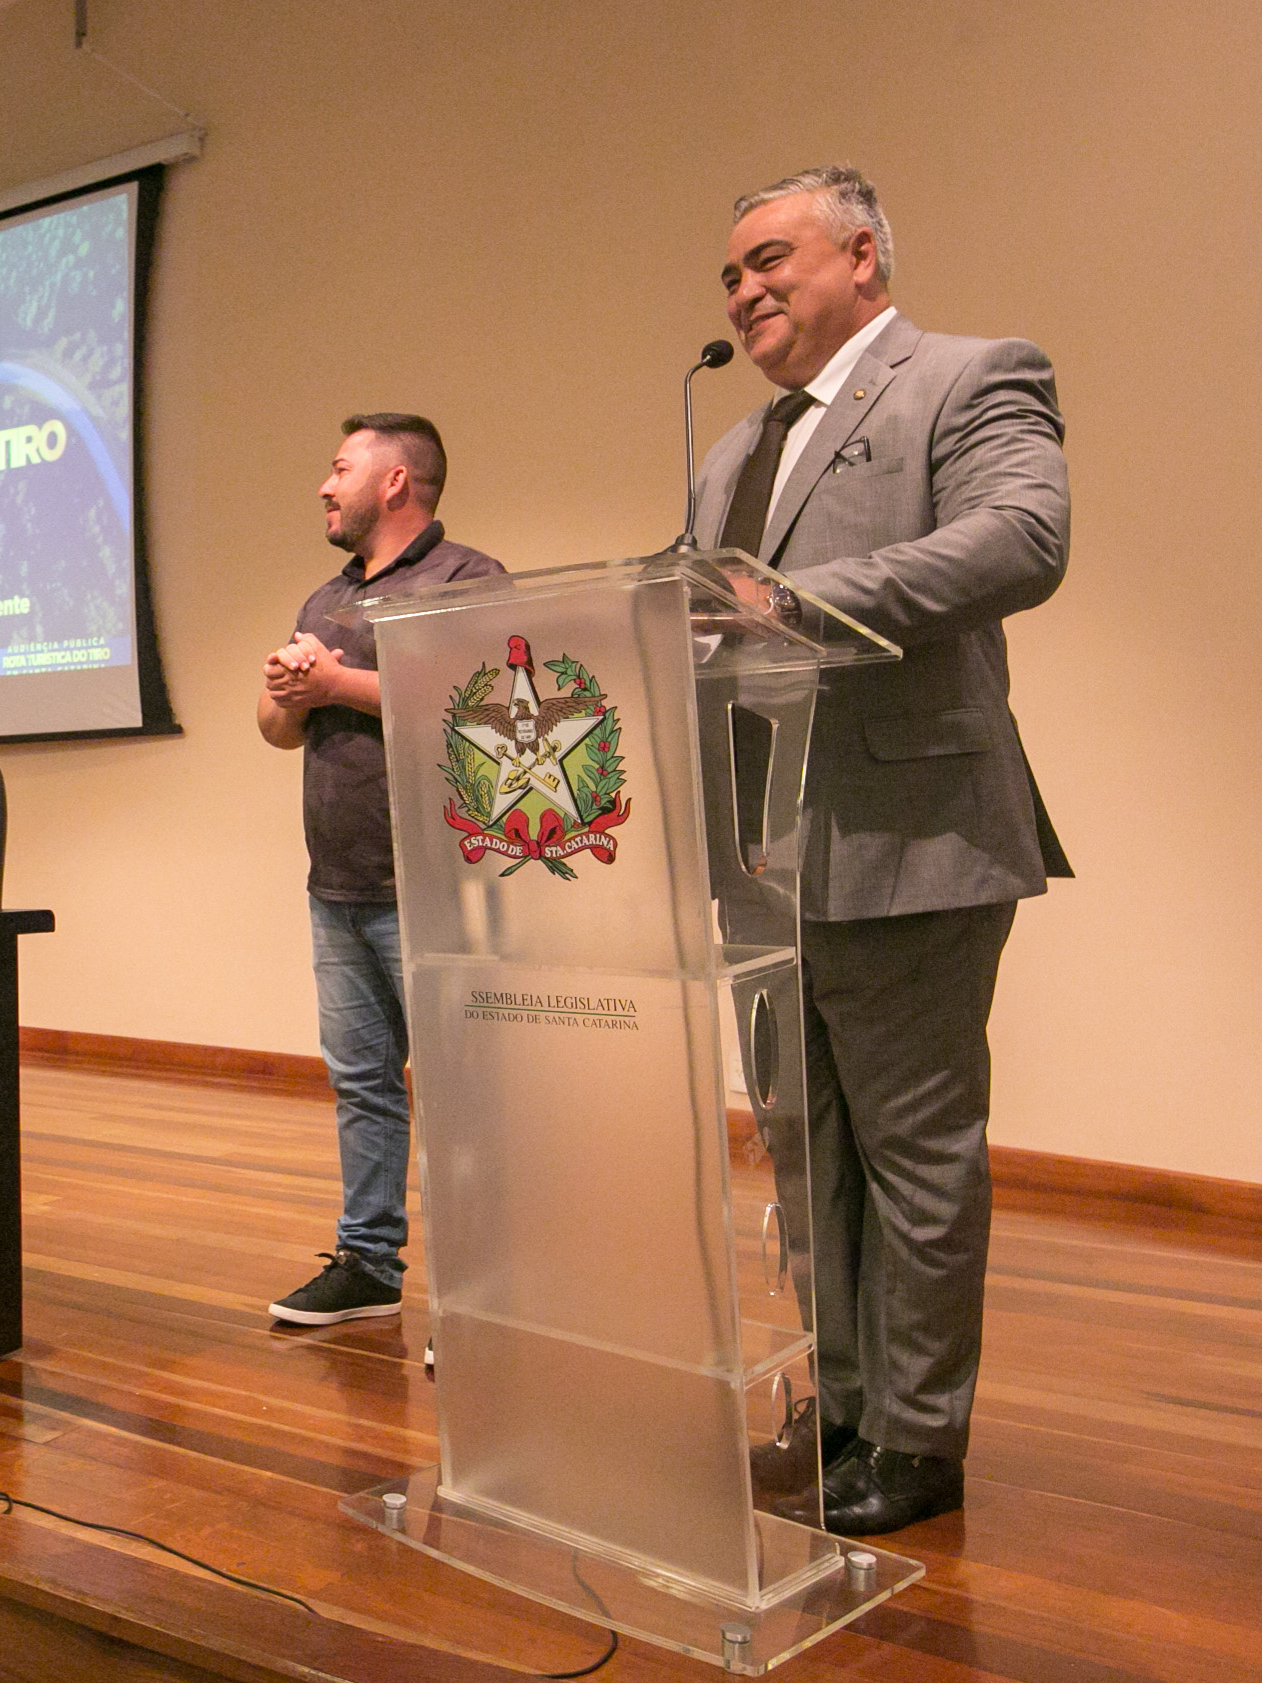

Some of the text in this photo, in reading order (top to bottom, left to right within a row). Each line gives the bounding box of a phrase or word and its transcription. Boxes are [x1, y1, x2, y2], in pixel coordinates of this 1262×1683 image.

[2, 655, 26, 669] ROTA
[72, 649, 87, 662] DO
[87, 647, 110, 661] TIRO
[464, 835, 507, 851] ESTADO
[508, 845, 523, 856] DE
[547, 995, 638, 1013] LEGISLATIVA
[464, 1009, 639, 1031] DO ESTADO DE SANTA CATARINA
